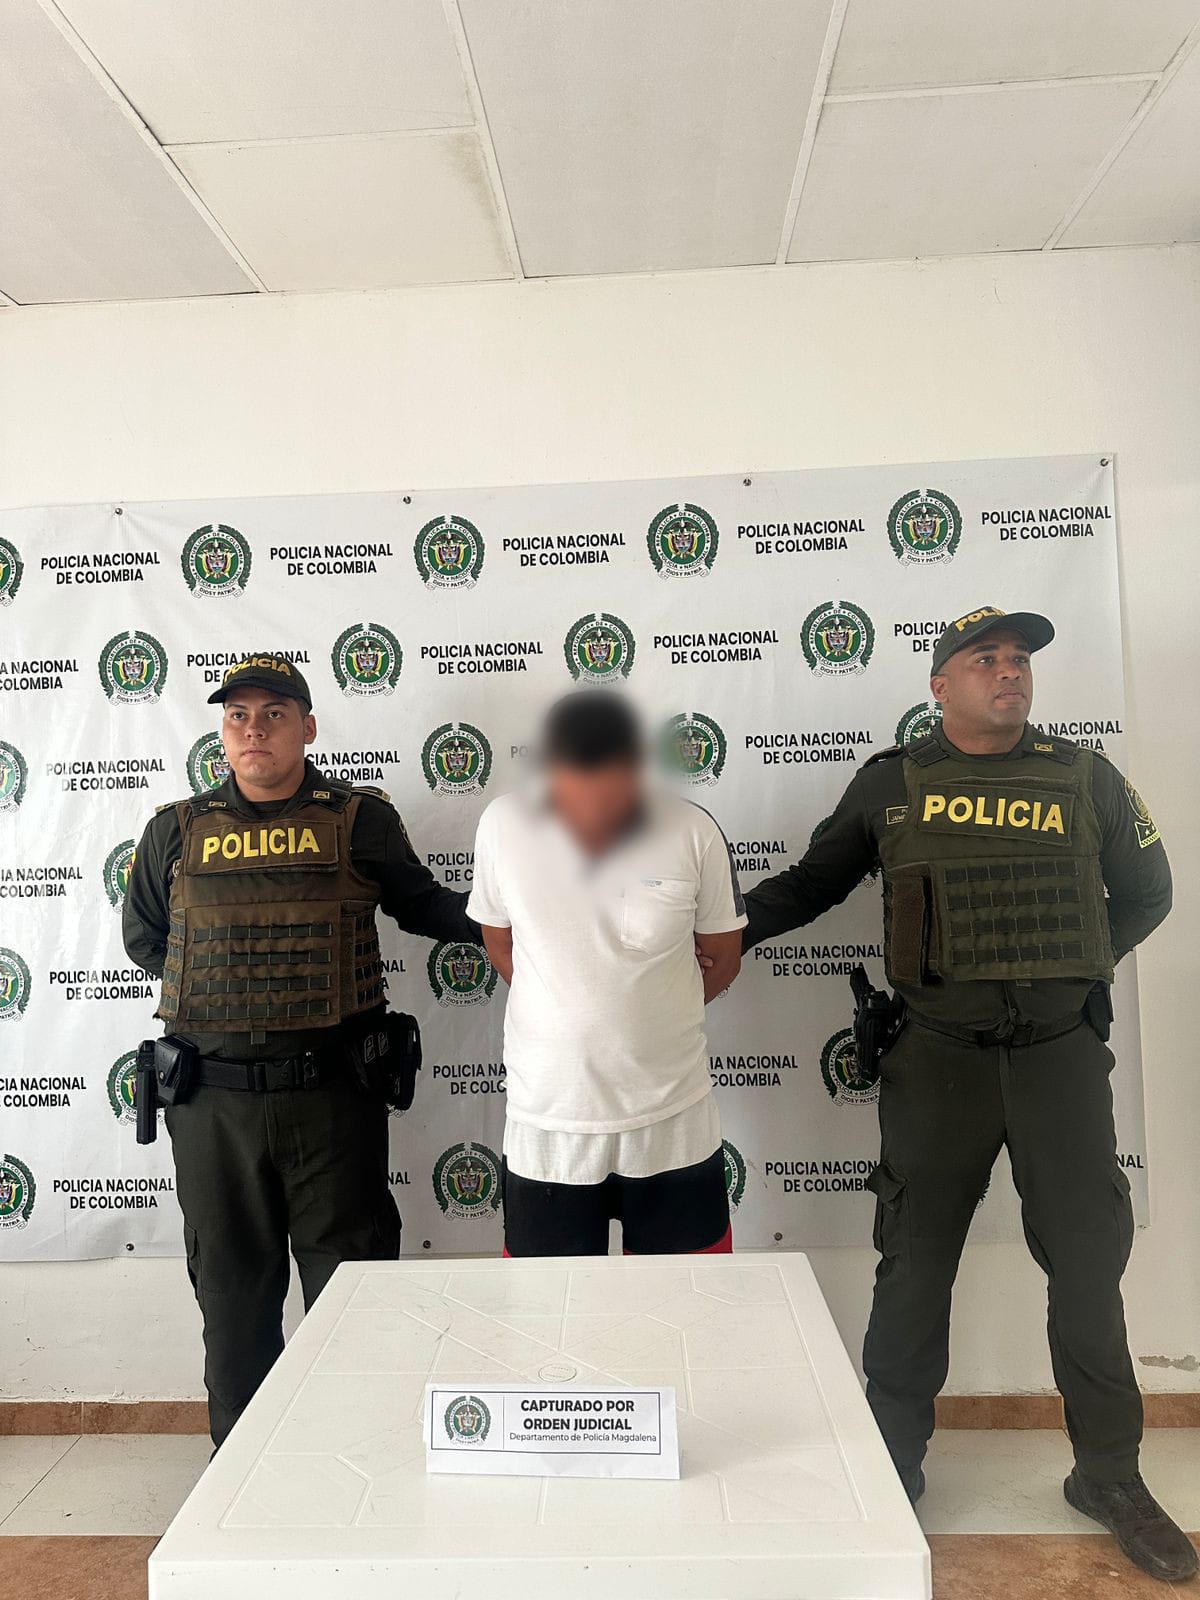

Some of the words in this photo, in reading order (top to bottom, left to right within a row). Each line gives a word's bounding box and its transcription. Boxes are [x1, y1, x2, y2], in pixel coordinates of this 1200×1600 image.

[982, 510, 1036, 525] POLICIA
[1039, 506, 1111, 522] NACIONAL
[738, 524, 790, 539] POLICIA
[794, 519, 865, 535] NACIONAL
[1000, 527, 1017, 541] DE
[1020, 523, 1094, 539] COLOMBIA
[503, 536, 554, 551] POLICIA
[557, 533, 626, 549] NACIONAL
[756, 541, 772, 554] DE
[775, 537, 848, 553] COLOMBIA
[270, 546, 321, 560] POLICIA
[325, 544, 393, 558] NACIONAL
[520, 554, 536, 566] DE
[539, 550, 609, 565] COLOMBIA
[41, 555, 90, 570] POLICIA
[93, 552, 160, 567] NACIONAL
[288, 563, 304, 575] DE
[307, 560, 377, 575] COLOMBIA
[57, 572, 72, 584] DE
[75, 568, 143, 584] COLOMBIA
[894, 621, 947, 637] POLICIA
[654, 634, 706, 649] POLICIA
[709, 630, 779, 646] NACIONAL
[913, 639, 930, 652] DE
[421, 645, 472, 659] POLICIA
[475, 641, 543, 657] NACIONAL
[671, 651, 688, 664] DE
[691, 648, 762, 663] COLOMBIA
[11, 659, 79, 674] NACIONAL
[187, 653, 237, 667] POLICIA
[438, 662, 454, 674] DE
[457, 659, 527, 673] COLOMBIA
[205, 670, 220, 682] DE
[224, 657, 291, 682] POLICIA
[1048, 720, 1123, 736] NACIONAL
[746, 734, 799, 749] POLICIA
[801, 731, 873, 746] NACIONAL
[332, 751, 400, 765] NACIONAL
[763, 751, 780, 764] DE
[783, 748, 856, 763] COLOMBIA
[47, 762, 95, 777] POLICIA
[98, 759, 165, 774] NACIONAL
[323, 767, 384, 781] OLOMBIA
[62, 778, 77, 791] DE
[80, 776, 149, 790] COLOMBIA
[922, 794, 1065, 835] POLICIA
[202, 827, 321, 864] POLICIA
[729, 840, 787, 855] ACIONAL
[736, 857, 771, 871] MBIA
[17, 867, 82, 881] NACIONAL
[445, 869, 463, 882] DE
[755, 946, 808, 960] POLICIA
[811, 944, 884, 959] NACIONAL
[50, 971, 98, 984] POLICIA
[101, 969, 159, 983] NACION
[773, 963, 790, 976] DE
[67, 987, 81, 1000] DE
[85, 985, 153, 1000] COLOMBIA
[727, 1055, 798, 1070] NACIONAL
[433, 1063, 485, 1079] POLICIA
[21, 1077, 86, 1091] NACIONAL
[451, 1081, 467, 1095] DE
[470, 1080, 507, 1094] COLO
[4, 1094, 70, 1107] COLOMBIA
[765, 1162, 820, 1176] POLICIA
[822, 1160, 879, 1175] NACION
[54, 1179, 103, 1192] POLICIA
[106, 1178, 174, 1192] NACIONAL
[784, 1179, 800, 1192] DE
[70, 1196, 85, 1209] DE
[89, 1195, 158, 1209] COLOMBIA
[521, 1400, 603, 1412] CAPTURADO
[606, 1400, 634, 1412] POR
[523, 1418, 570, 1430] ORDEN
[574, 1419, 632, 1431] JUDICIAL
[510, 1433, 570, 1442] Departamento
[571, 1433, 581, 1441] de
[612, 1434, 656, 1443] Magdalena
